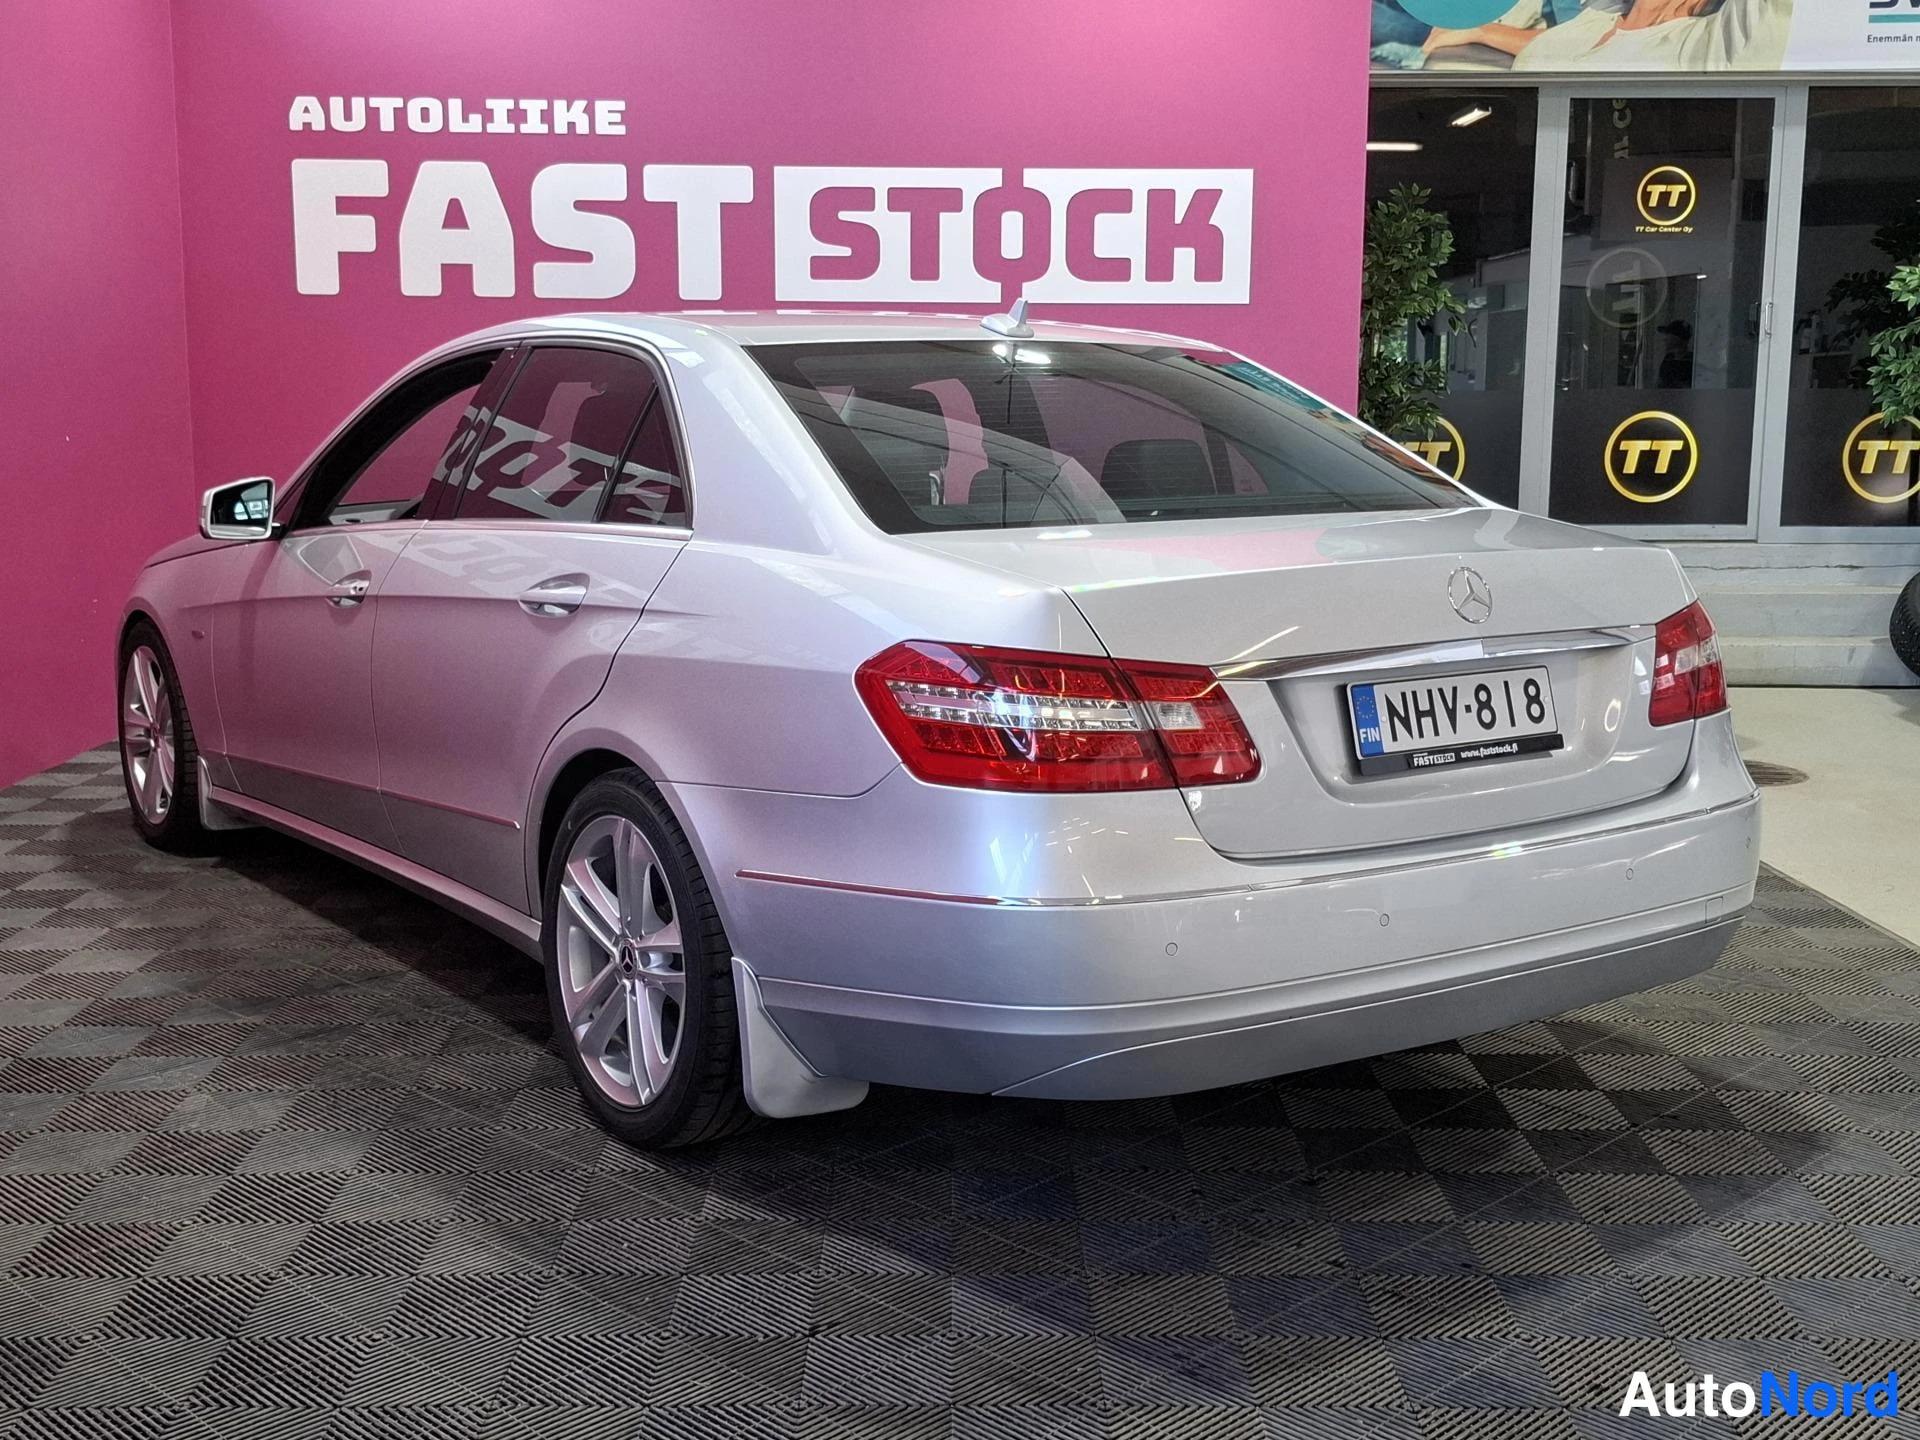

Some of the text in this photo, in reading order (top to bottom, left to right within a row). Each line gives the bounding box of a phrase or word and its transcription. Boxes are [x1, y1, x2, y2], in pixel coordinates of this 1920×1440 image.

[289, 96, 626, 135] AUTOLIIKE
[1646, 184, 1687, 207] TT
[291, 158, 1224, 301] FAST STOCK
[1619, 440, 1684, 474] TT
[1858, 440, 1920, 474] TT
[1385, 678, 1546, 743] NHV-818
[1359, 727, 1380, 743] FIN
[1413, 755, 1435, 767] FAST
[1460, 743, 1518, 758] www.faststock.fi
